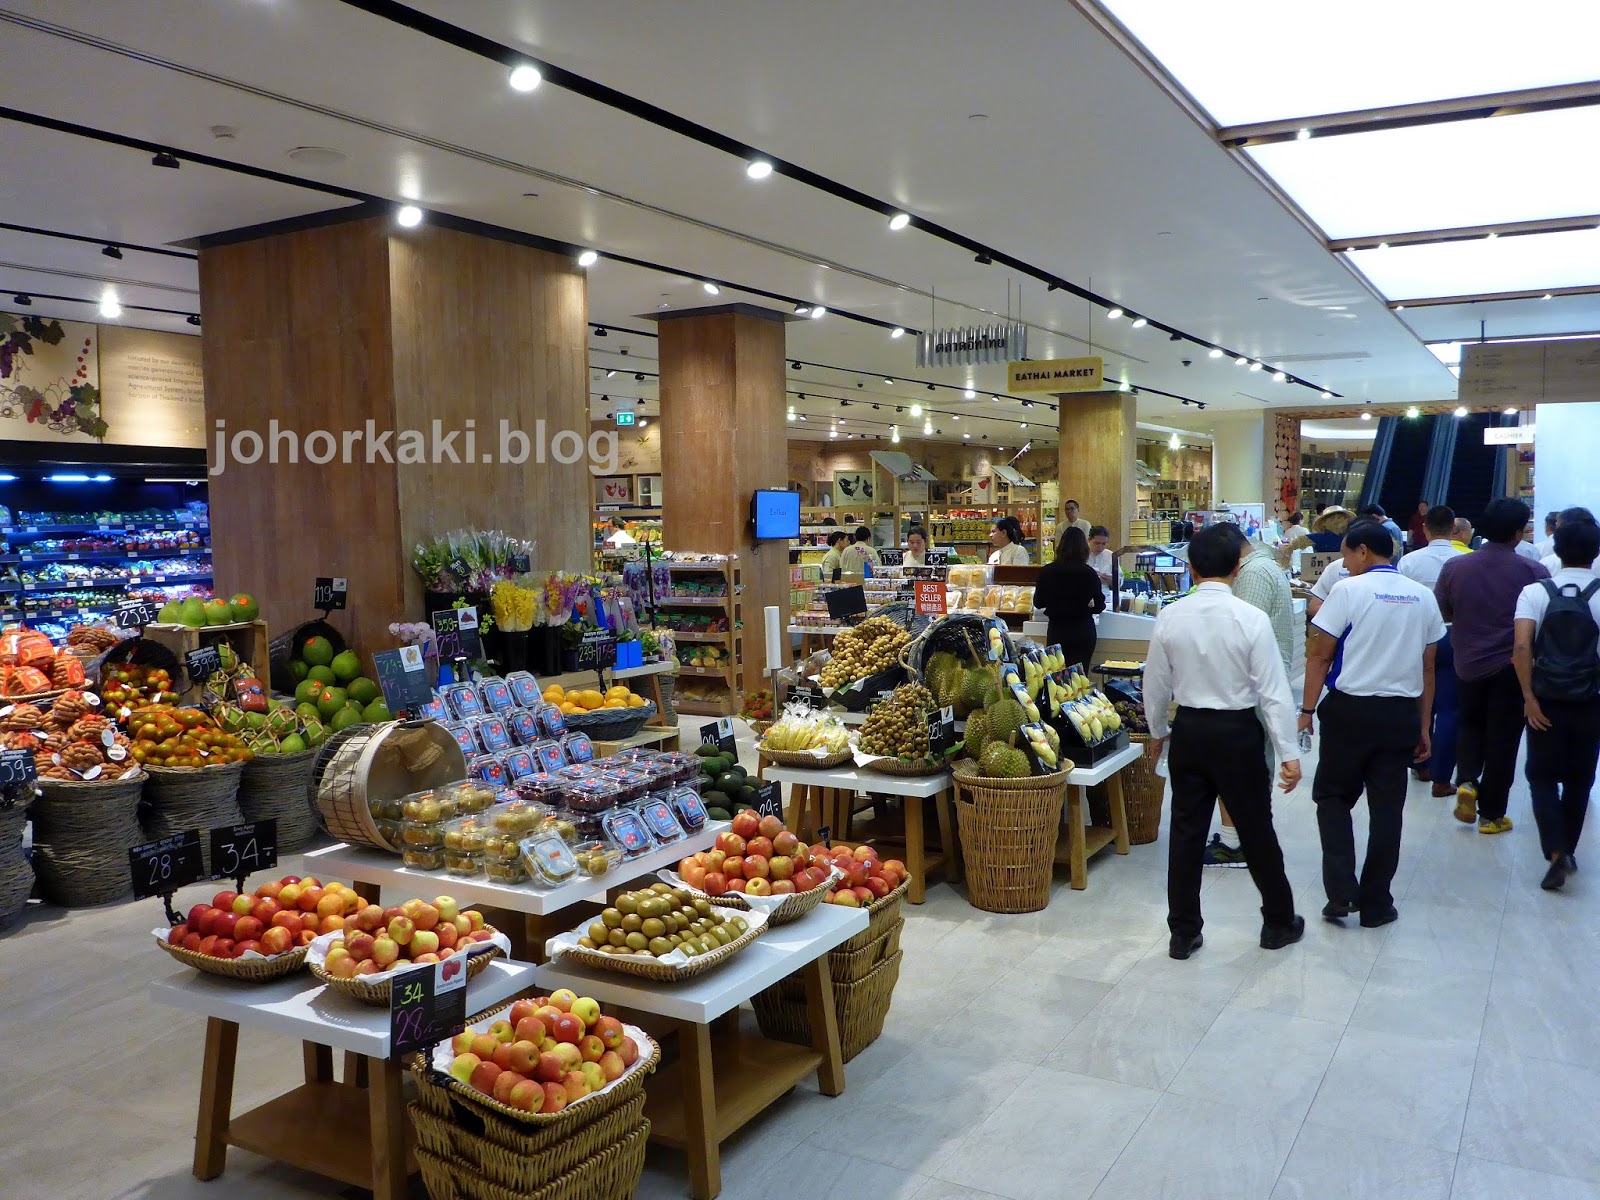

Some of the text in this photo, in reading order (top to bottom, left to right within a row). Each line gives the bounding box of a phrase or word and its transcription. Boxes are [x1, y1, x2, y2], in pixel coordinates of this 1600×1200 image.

[1015, 368, 1095, 381] EATHAI MARKET
[922, 584, 938, 593] BEST
[920, 593, 942, 602] SELLER
